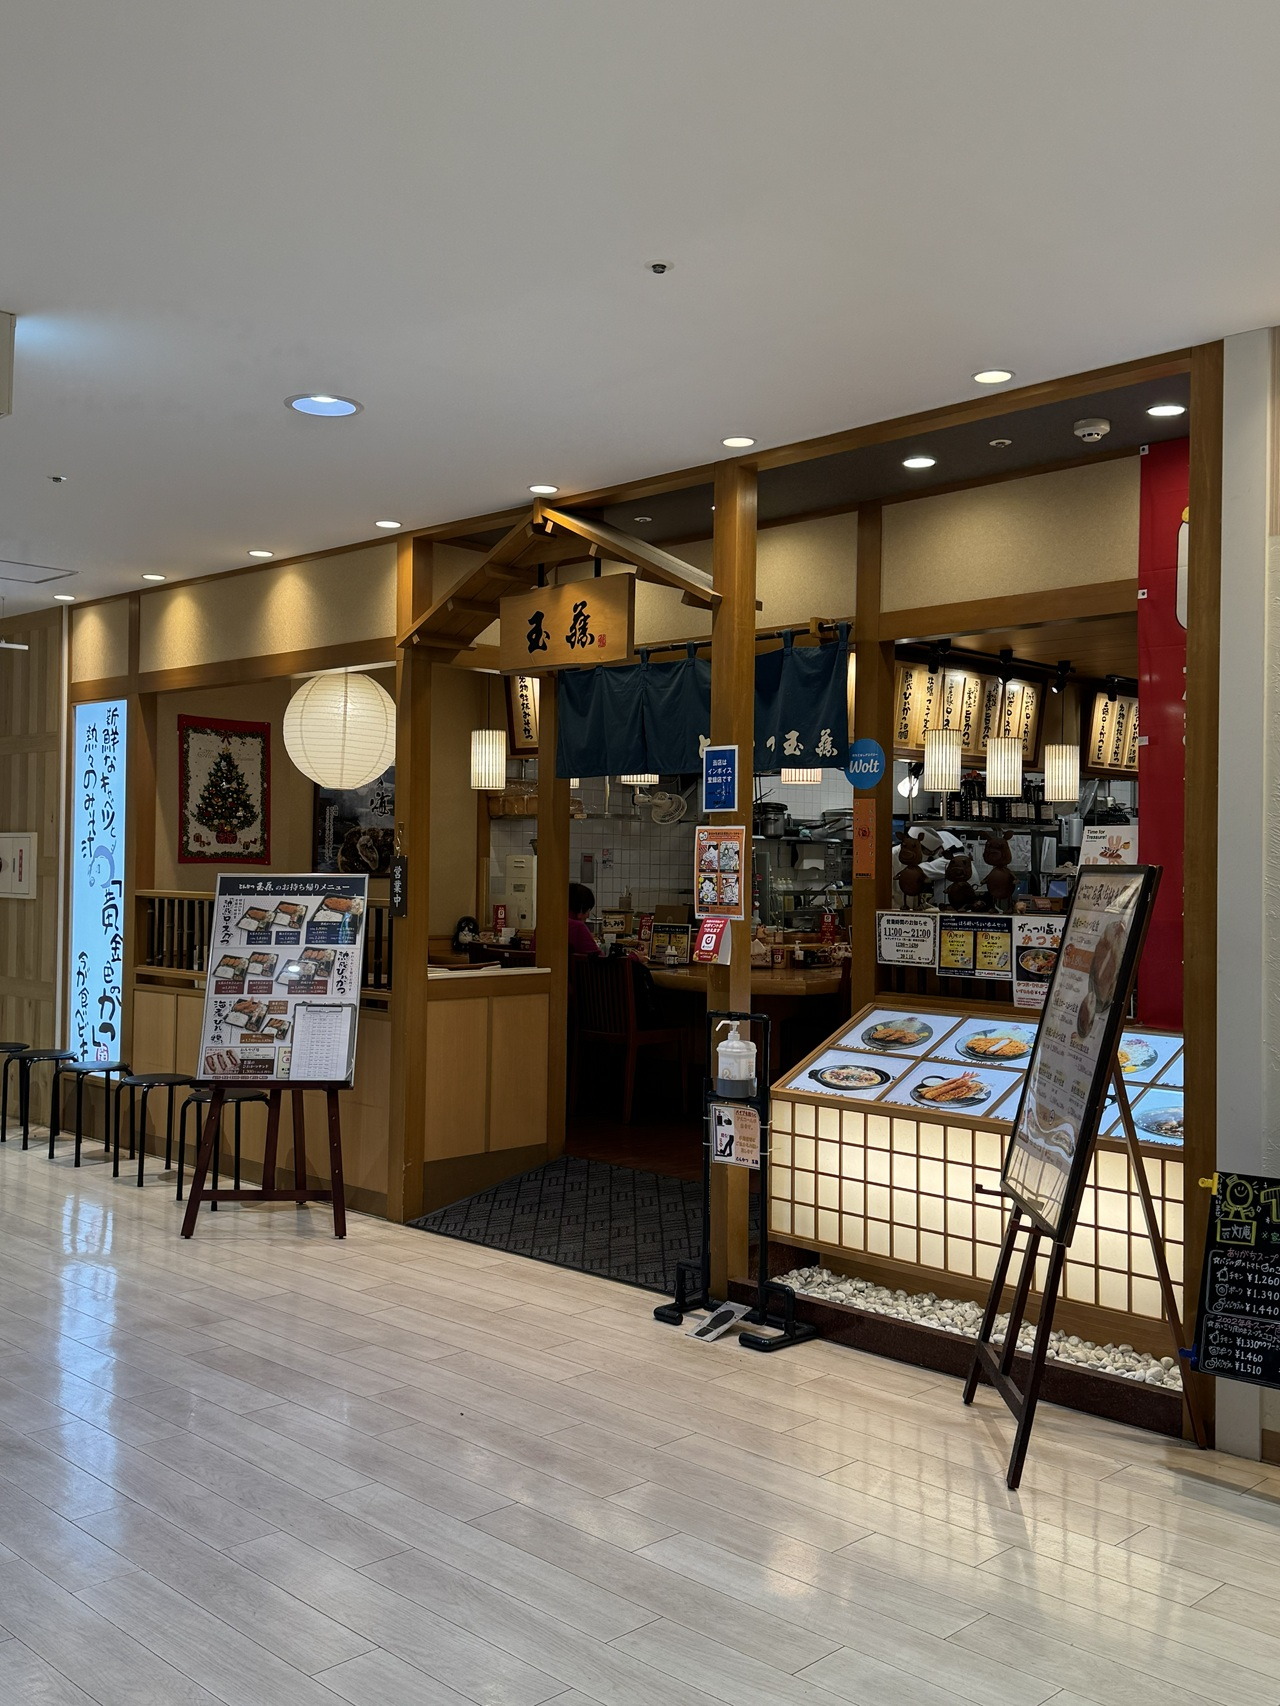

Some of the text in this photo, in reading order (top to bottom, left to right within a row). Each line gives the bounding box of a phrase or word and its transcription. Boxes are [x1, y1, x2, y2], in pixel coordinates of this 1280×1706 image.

[849, 760, 880, 774] Wolt
[393, 866, 403, 908] 営業中
